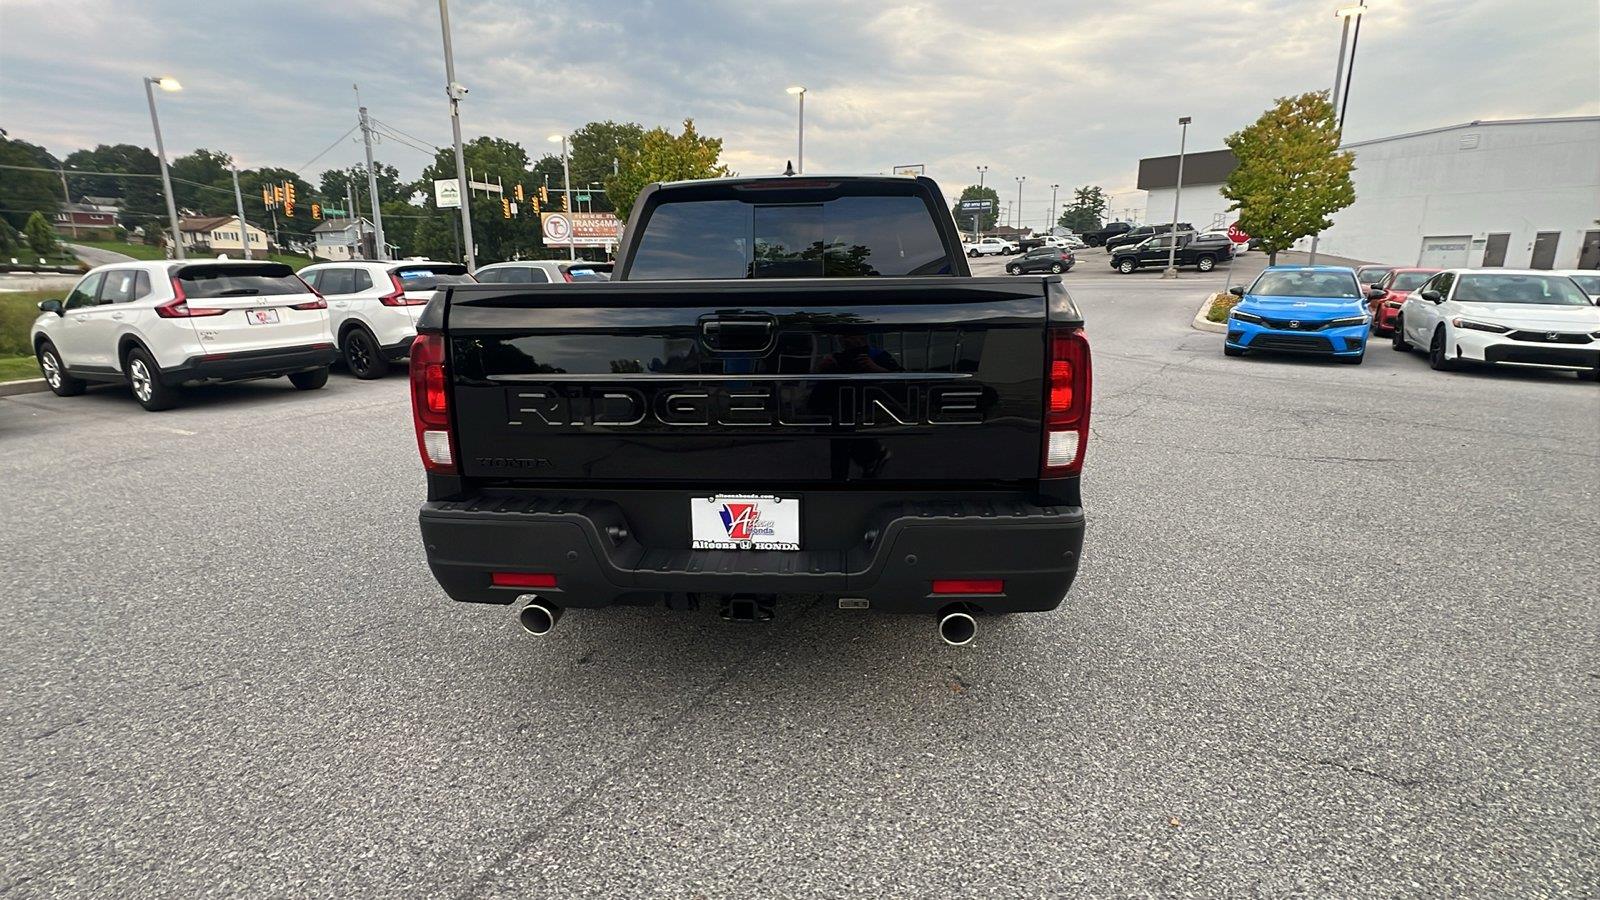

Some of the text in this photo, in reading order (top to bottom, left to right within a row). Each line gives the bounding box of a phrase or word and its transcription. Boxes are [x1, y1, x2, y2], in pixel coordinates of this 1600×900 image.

[572, 219, 619, 228] TRANS4MA
[1229, 226, 1248, 236] STO
[503, 385, 985, 427] RIDGELINE
[692, 540, 800, 551] Altoona HONDA
